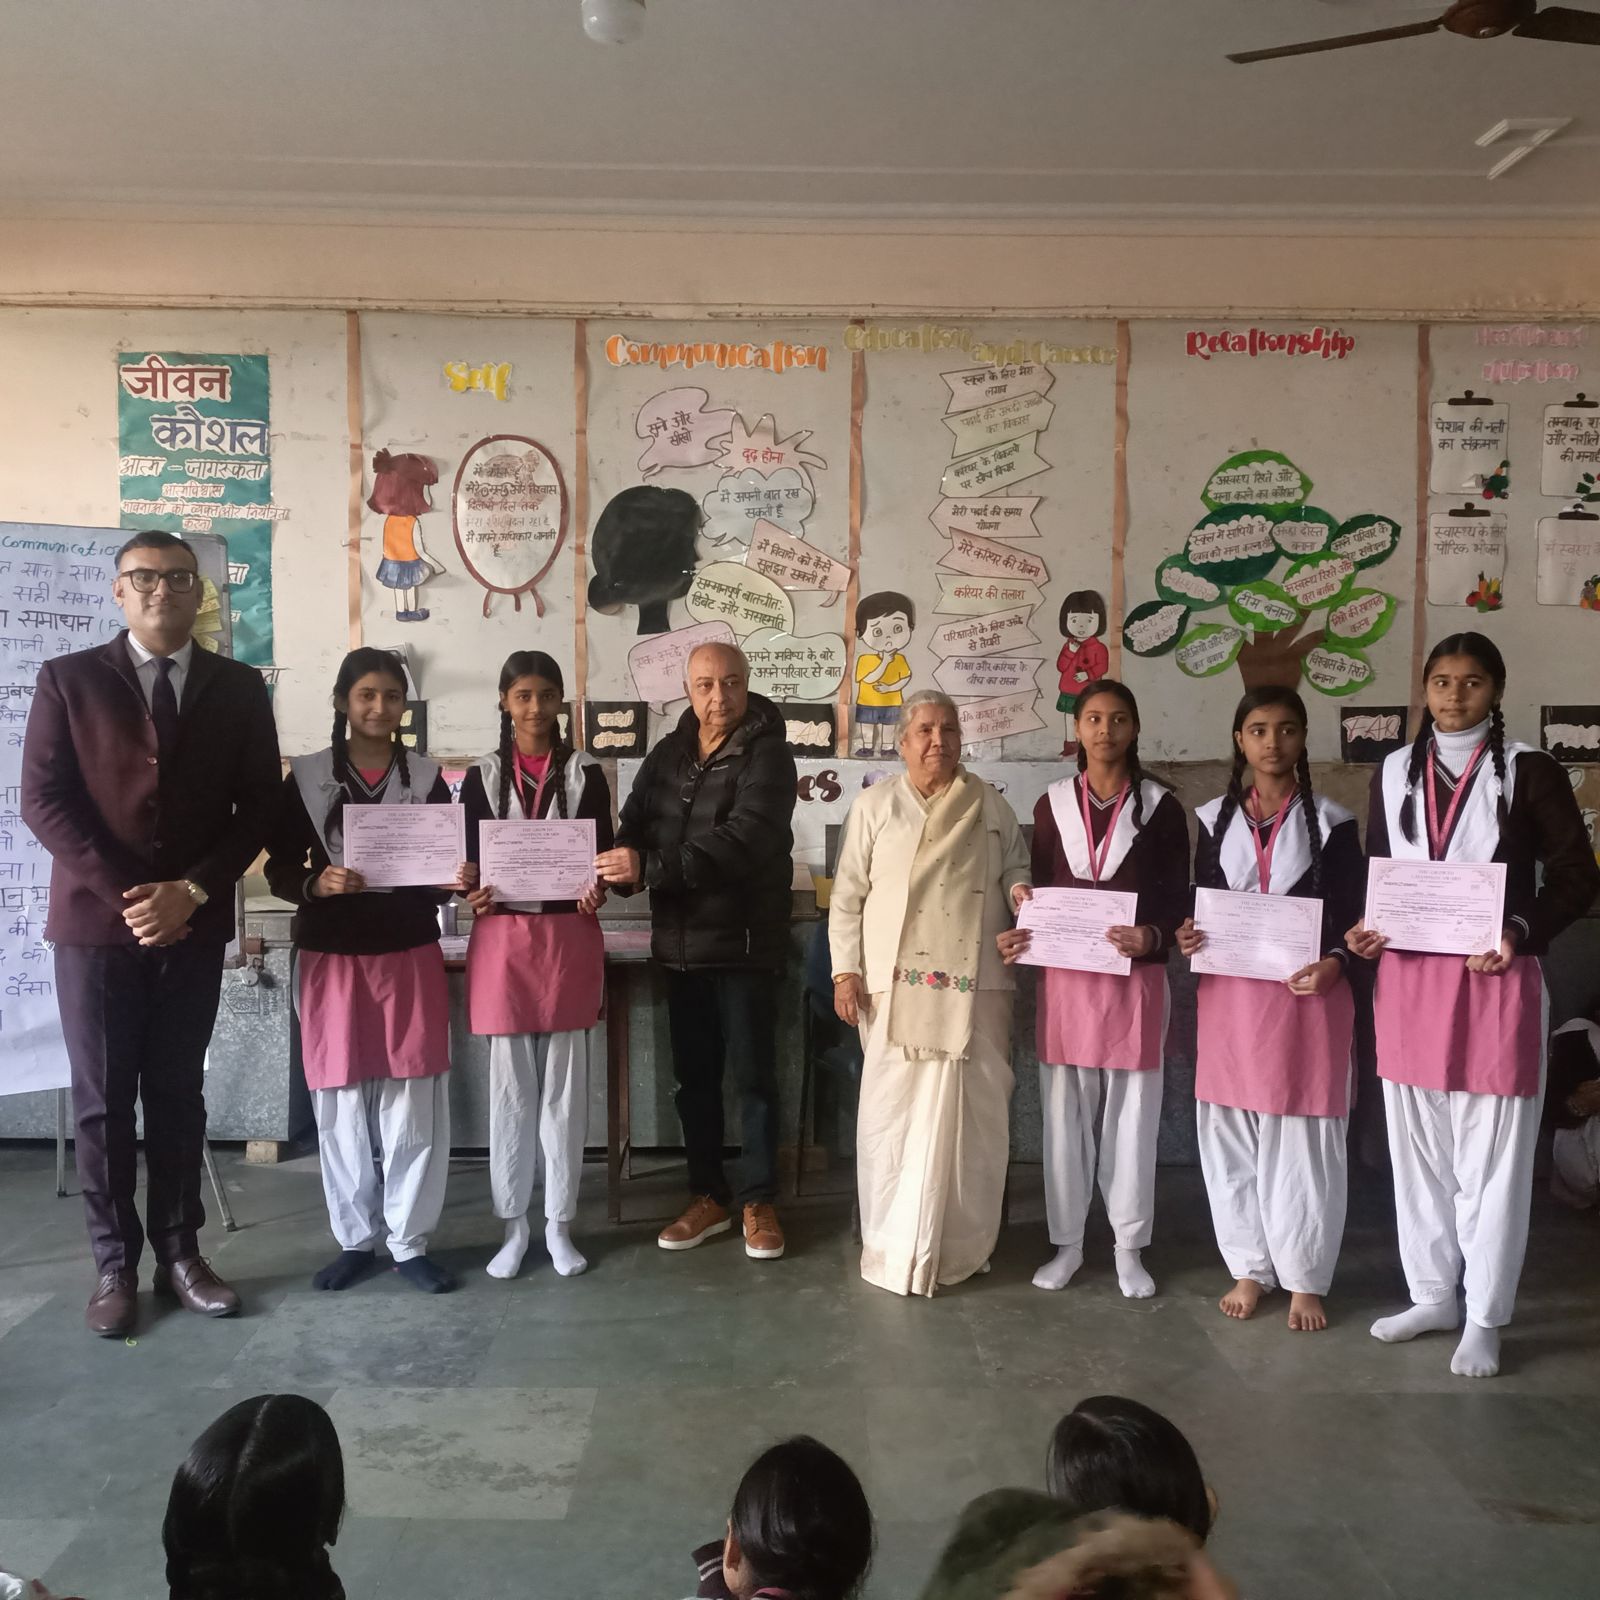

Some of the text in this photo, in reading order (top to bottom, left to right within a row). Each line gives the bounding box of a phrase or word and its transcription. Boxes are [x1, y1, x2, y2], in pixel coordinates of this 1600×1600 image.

[1186, 326, 1355, 361] Relationship
[605, 334, 828, 374] Communication
[122, 355, 230, 400] जीवन
[151, 405, 268, 454] कौशल
[1434, 417, 1466, 433] पेशाब
[1469, 416, 1483, 433] की
[1438, 438, 1454, 450] का
[1545, 429, 1567, 446] और
[1560, 447, 1575, 462] की
[2, 536, 122, 556] Communicatio
[13, 581, 50, 603] सही
[691, 590, 716, 610] डिबेट
[985, 585, 999, 599] की
[1237, 590, 1261, 610] टीम
[18, 610, 95, 632] समाधान
[0, 634, 44, 653] शानी
[806, 648, 818, 661] के
[780, 664, 811, 678] परिवार
[825, 664, 842, 677] बात
